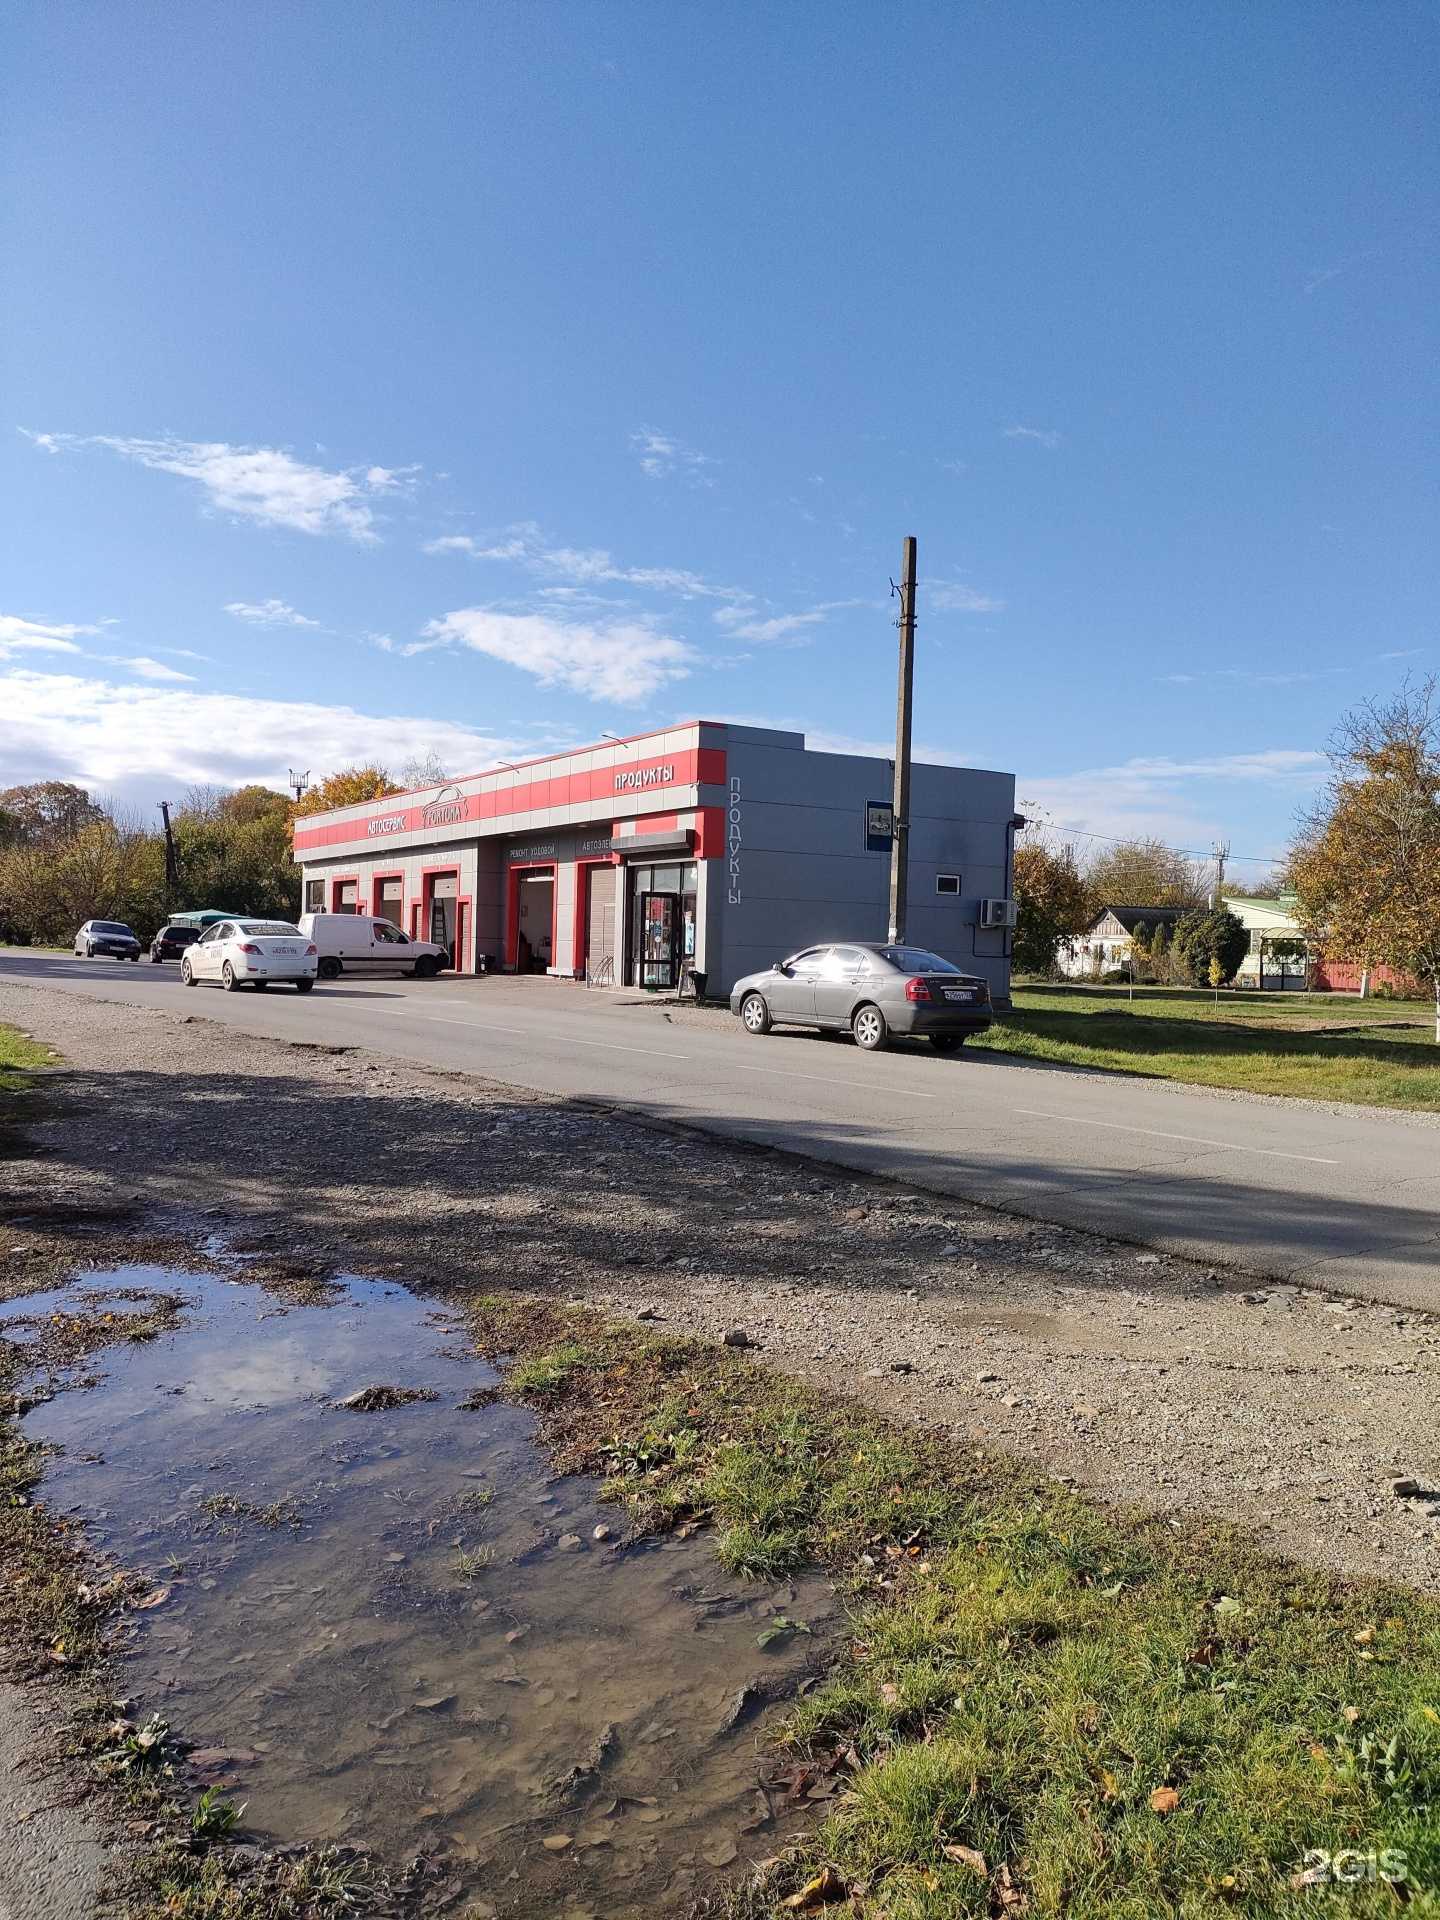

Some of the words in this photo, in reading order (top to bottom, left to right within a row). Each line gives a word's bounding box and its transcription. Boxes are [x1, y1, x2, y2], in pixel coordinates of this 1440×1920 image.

[615, 765, 673, 791] ПРОДУКТЫ
[368, 815, 406, 836] АВТОСЕРВИС
[583, 839, 611, 851] АВТОЭЛЕ
[728, 776, 741, 904] ПРОДУКТЫ
